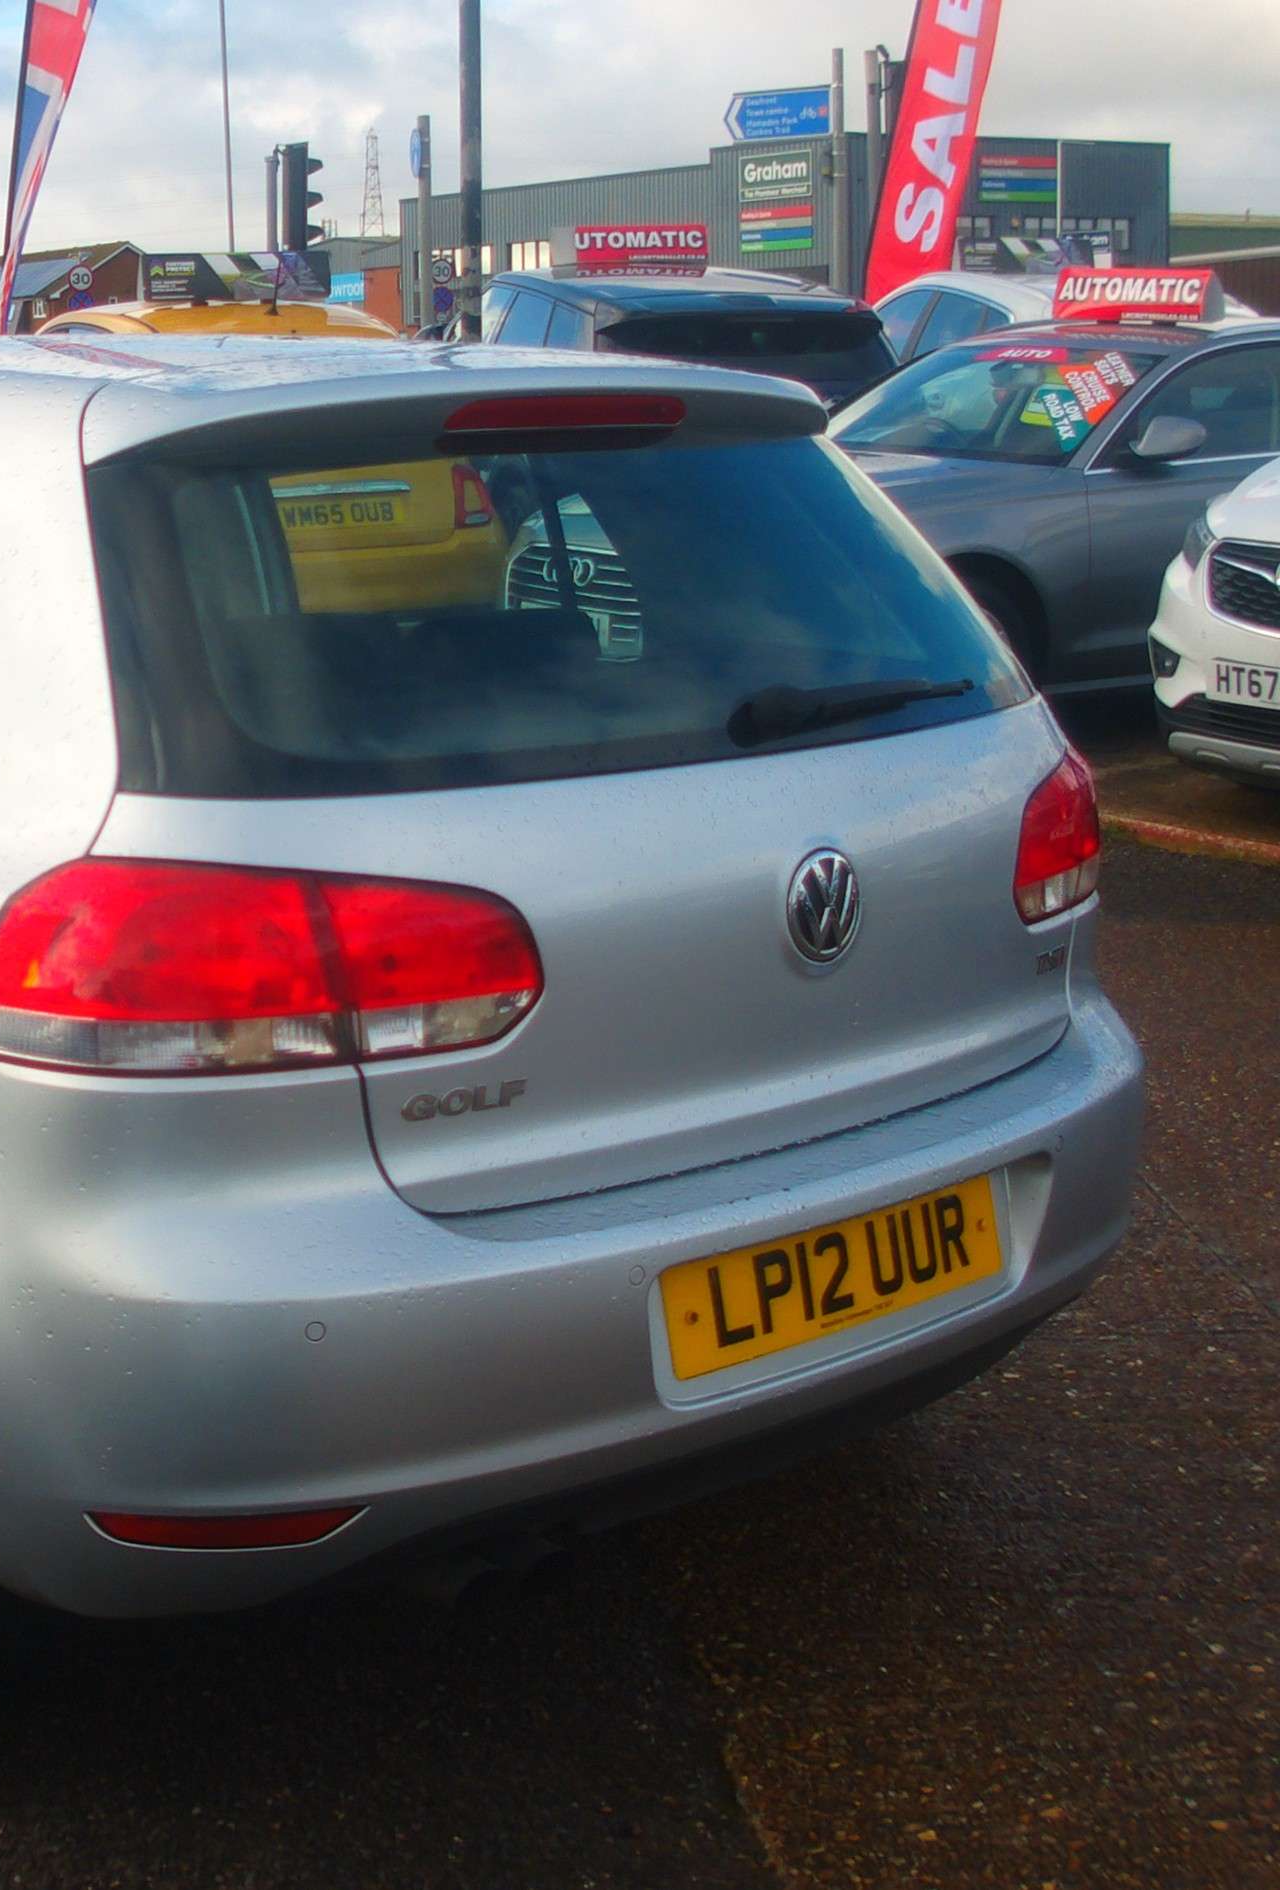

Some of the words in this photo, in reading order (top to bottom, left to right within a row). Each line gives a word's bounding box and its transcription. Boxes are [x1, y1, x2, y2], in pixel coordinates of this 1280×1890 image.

[894, 0, 983, 252] SALE
[743, 160, 807, 183] Graham
[574, 231, 703, 249] UTOMATIC
[72, 273, 90, 285] 30
[434, 266, 450, 277] 30
[1059, 277, 1201, 303] AUTOMATIC
[998, 348, 1053, 359] AUTO
[1064, 371, 1097, 412] CONTROL
[1082, 370, 1110, 403] CRUISE
[1042, 393, 1064, 419] ROAD
[1055, 417, 1076, 441] TAX
[1063, 400, 1083, 422] LOW
[282, 502, 345, 528] WM65
[1216, 663, 1279, 700] HT67
[400, 1077, 528, 1121] GOLF
[708, 1231, 855, 1349] LP12
[865, 1194, 970, 1296] UUR
